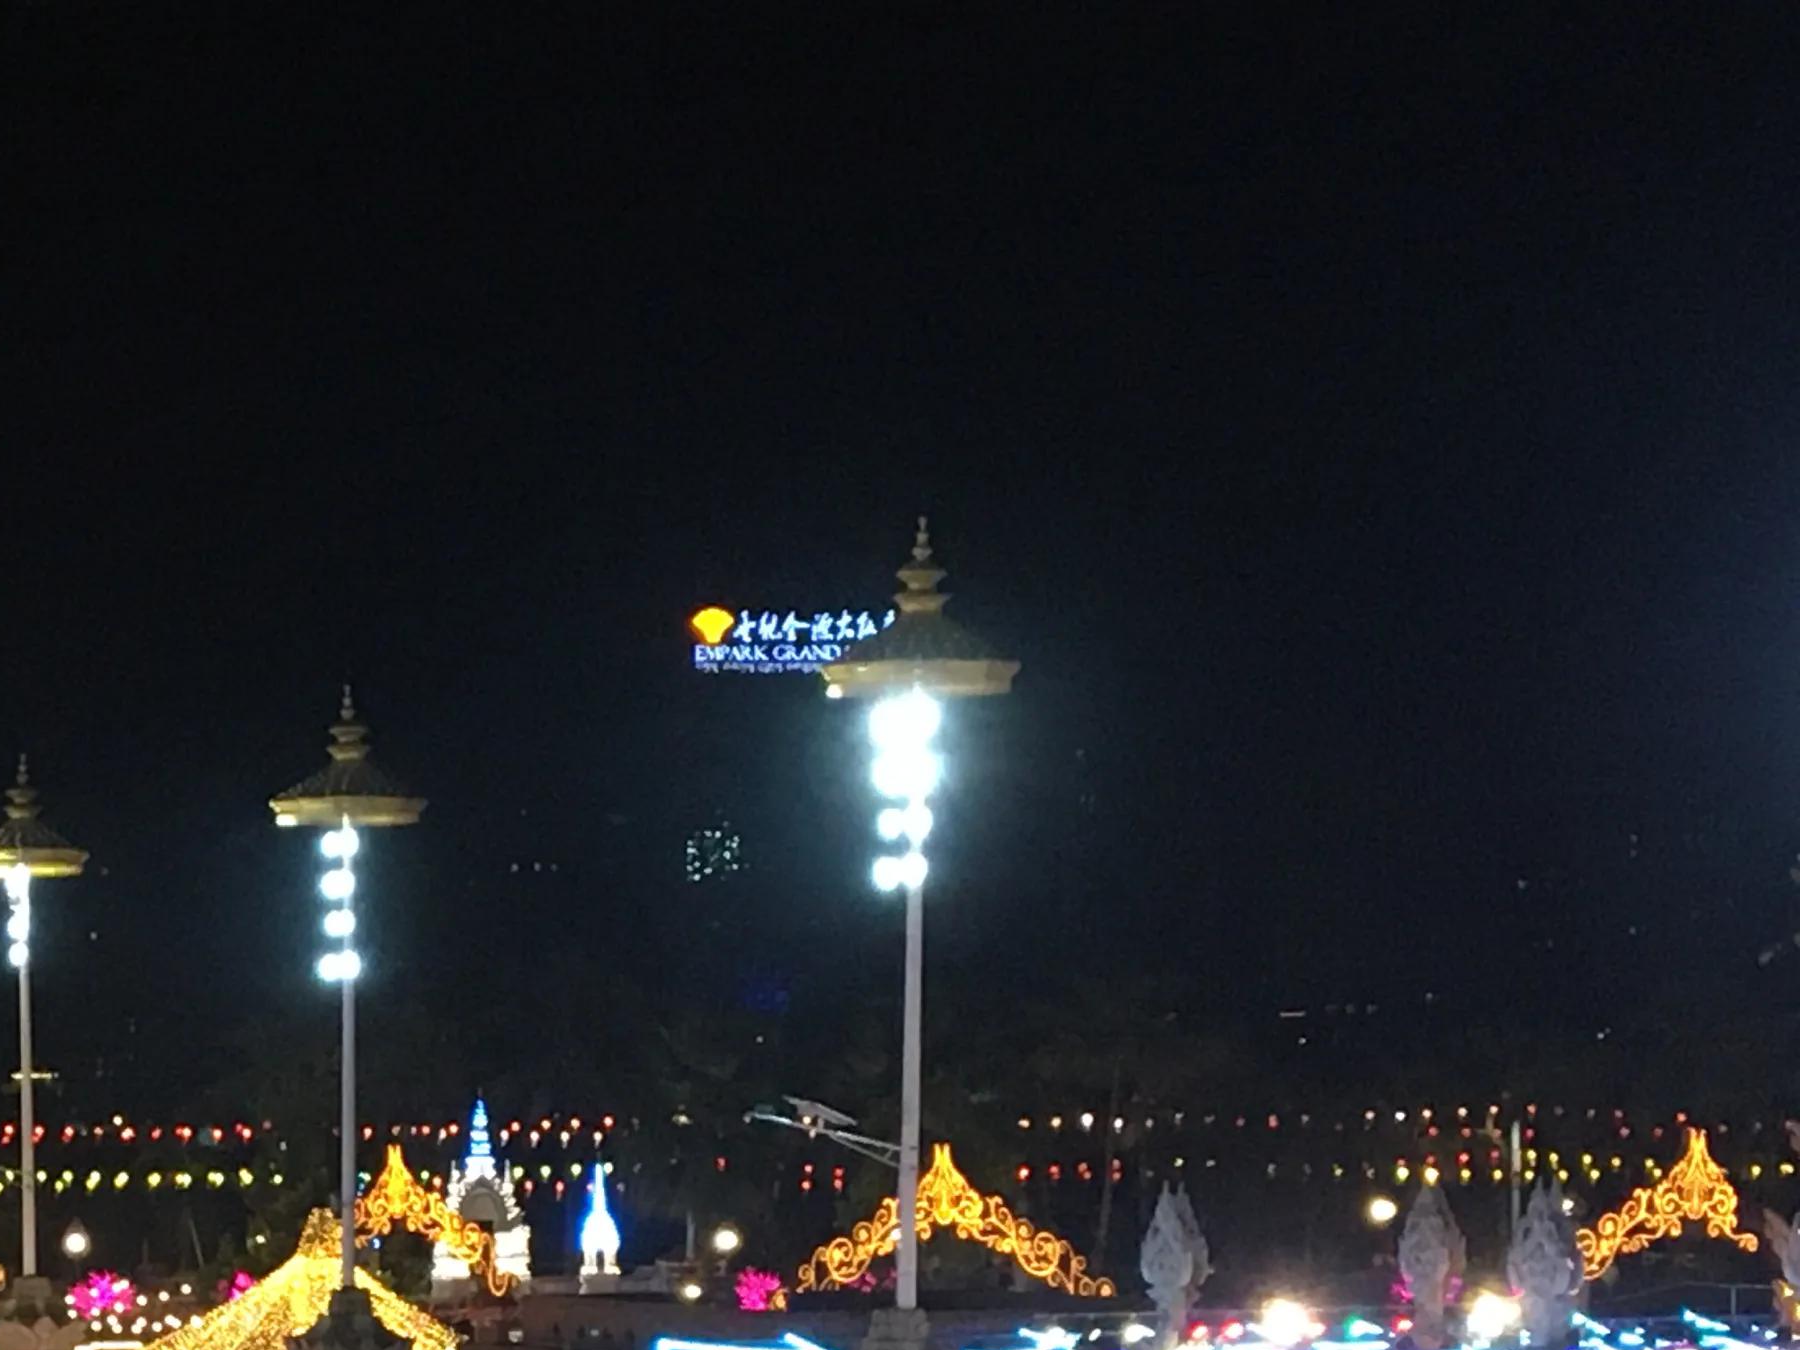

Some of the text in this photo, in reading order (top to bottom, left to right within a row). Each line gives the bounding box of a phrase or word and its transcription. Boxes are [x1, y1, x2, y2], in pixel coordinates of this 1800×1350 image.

[733, 609, 895, 641] 世纪金源大饭
[695, 644, 842, 662] EMPARK GRAND
